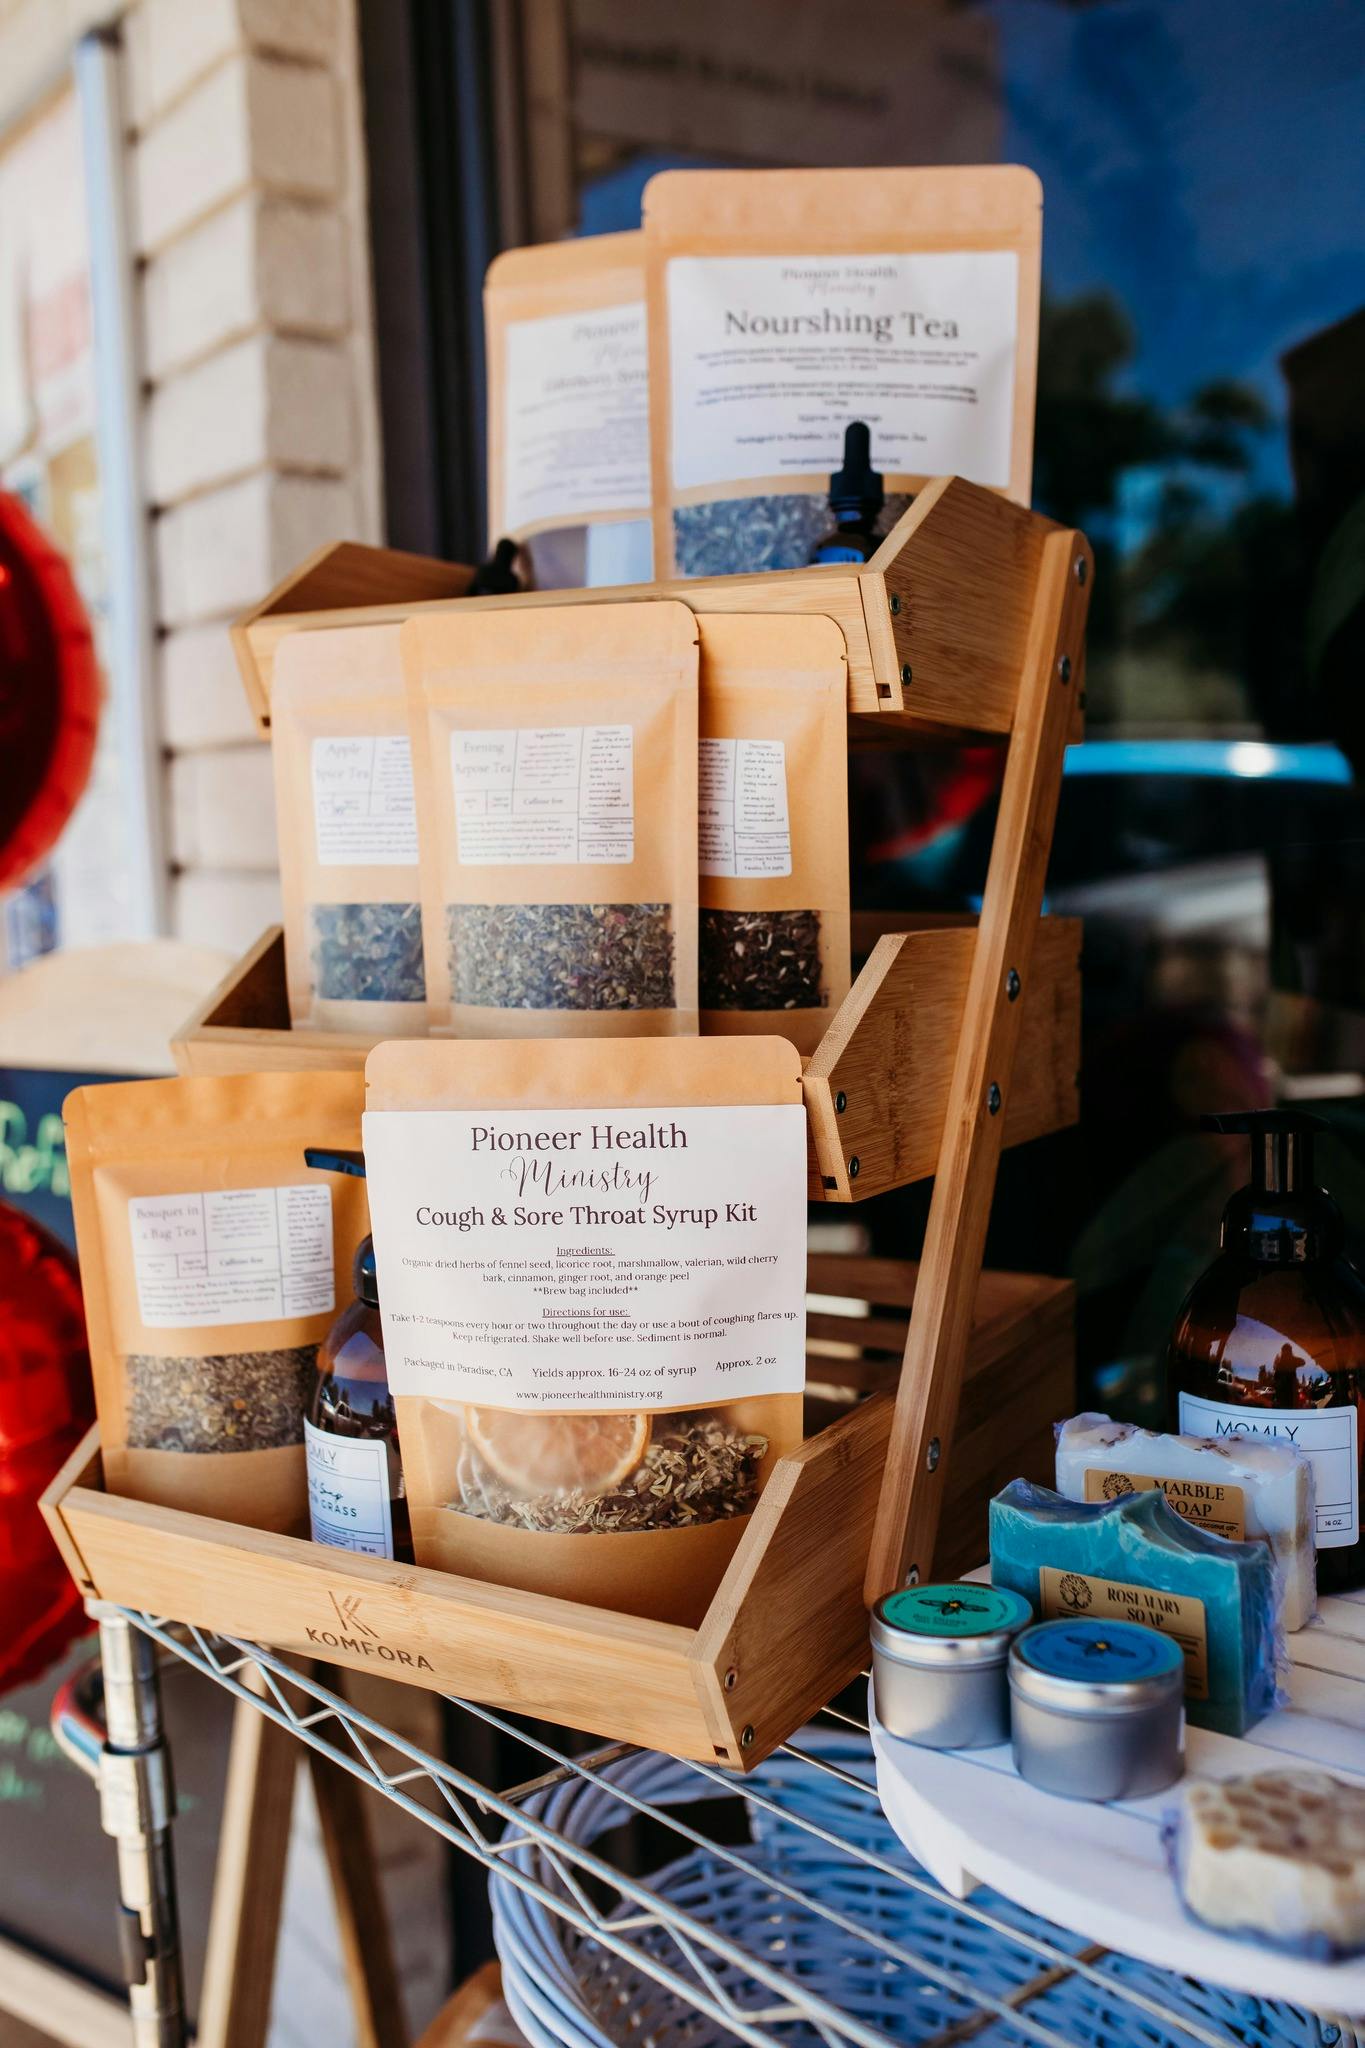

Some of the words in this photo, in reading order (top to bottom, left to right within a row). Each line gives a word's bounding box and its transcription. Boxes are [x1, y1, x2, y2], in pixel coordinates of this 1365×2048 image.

[724, 308, 894, 342] Nourshing
[902, 311, 960, 340] Tea
[471, 1126, 581, 1151] Pioneer
[591, 1123, 689, 1149] Health
[500, 1155, 660, 1204] Ministry
[416, 1206, 485, 1232] Cough
[492, 1207, 508, 1226] &
[514, 1207, 564, 1226] Sore
[570, 1205, 647, 1226] Throat
[653, 1205, 718, 1230] Syrup
[725, 1202, 758, 1223] Kit
[556, 1246, 615, 1257] Ingredients:
[402, 1257, 433, 1268] Organic
[435, 1260, 457, 1268] dried
[459, 1260, 485, 1269] herbs
[487, 1260, 498, 1268] of
[499, 1260, 527, 1268] fennel
[529, 1260, 554, 1270] seed,
[556, 1259, 589, 1268] licorice
[593, 1260, 616, 1269] root,
[618, 1259, 683, 1268] marshmallow,
[685, 1258, 724, 1267] valerian,
[727, 1256, 746, 1265] wild
[748, 1255, 779, 1264] cherry
[483, 1273, 506, 1283] bark,
[508, 1273, 556, 1283] cinnamon,
[558, 1274, 588, 1284] ginger
[590, 1274, 613, 1282] root,
[615, 1272, 632, 1281] and
[635, 1273, 667, 1283] orange
[670, 1271, 690, 1283] peel
[569, 1286, 586, 1297] bag
[391, 1314, 410, 1323] Take
[412, 1315, 424, 1323] 1-2
[426, 1316, 464, 1329] teaspoons
[465, 1322, 489, 1331] every
[491, 1321, 512, 1330] hour
[528, 1322, 545, 1330] two
[548, 1321, 600, 1331] throughout
[603, 1320, 618, 1329] the
[621, 1320, 637, 1331] day
[639, 1321, 649, 1329] or
[652, 1321, 668, 1329] use
[678, 1319, 700, 1328] bout
[702, 1317, 713, 1326] of
[714, 1313, 755, 1327] coughing
[757, 1311, 782, 1321] flares
[784, 1312, 799, 1321] up.
[542, 1308, 591, 1318] Directions
[593, 1307, 607, 1317] for
[609, 1308, 629, 1317] use:
[453, 1332, 473, 1343] Keep
[475, 1333, 530, 1345] refrigerated.
[532, 1334, 560, 1343] Shake
[562, 1334, 580, 1343] well
[583, 1333, 613, 1343] before
[616, 1334, 635, 1343] use.
[637, 1333, 680, 1342] Sediment
[683, 1331, 691, 1341] is
[693, 1329, 727, 1340] normal.
[404, 1357, 445, 1371] Packaged
[447, 1362, 455, 1371] in
[457, 1363, 497, 1377] Paradise,
[499, 1367, 513, 1377] CA
[715, 1358, 753, 1371] Approx.
[756, 1356, 763, 1366] 2
[764, 1356, 777, 1365] oz
[532, 1368, 563, 1377] Yields
[566, 1369, 605, 1380] approx.
[608, 1367, 636, 1377] 16-24
[639, 1369, 652, 1377] oz
[654, 1366, 666, 1376] of
[668, 1366, 697, 1378] syrup
[516, 1389, 663, 1401] www.pioneerhealthministry.org
[1153, 1480, 1225, 1502] MARBLE
[1127, 1608, 1164, 1626] SOAP
[306, 1627, 435, 1672] KOMFORA
